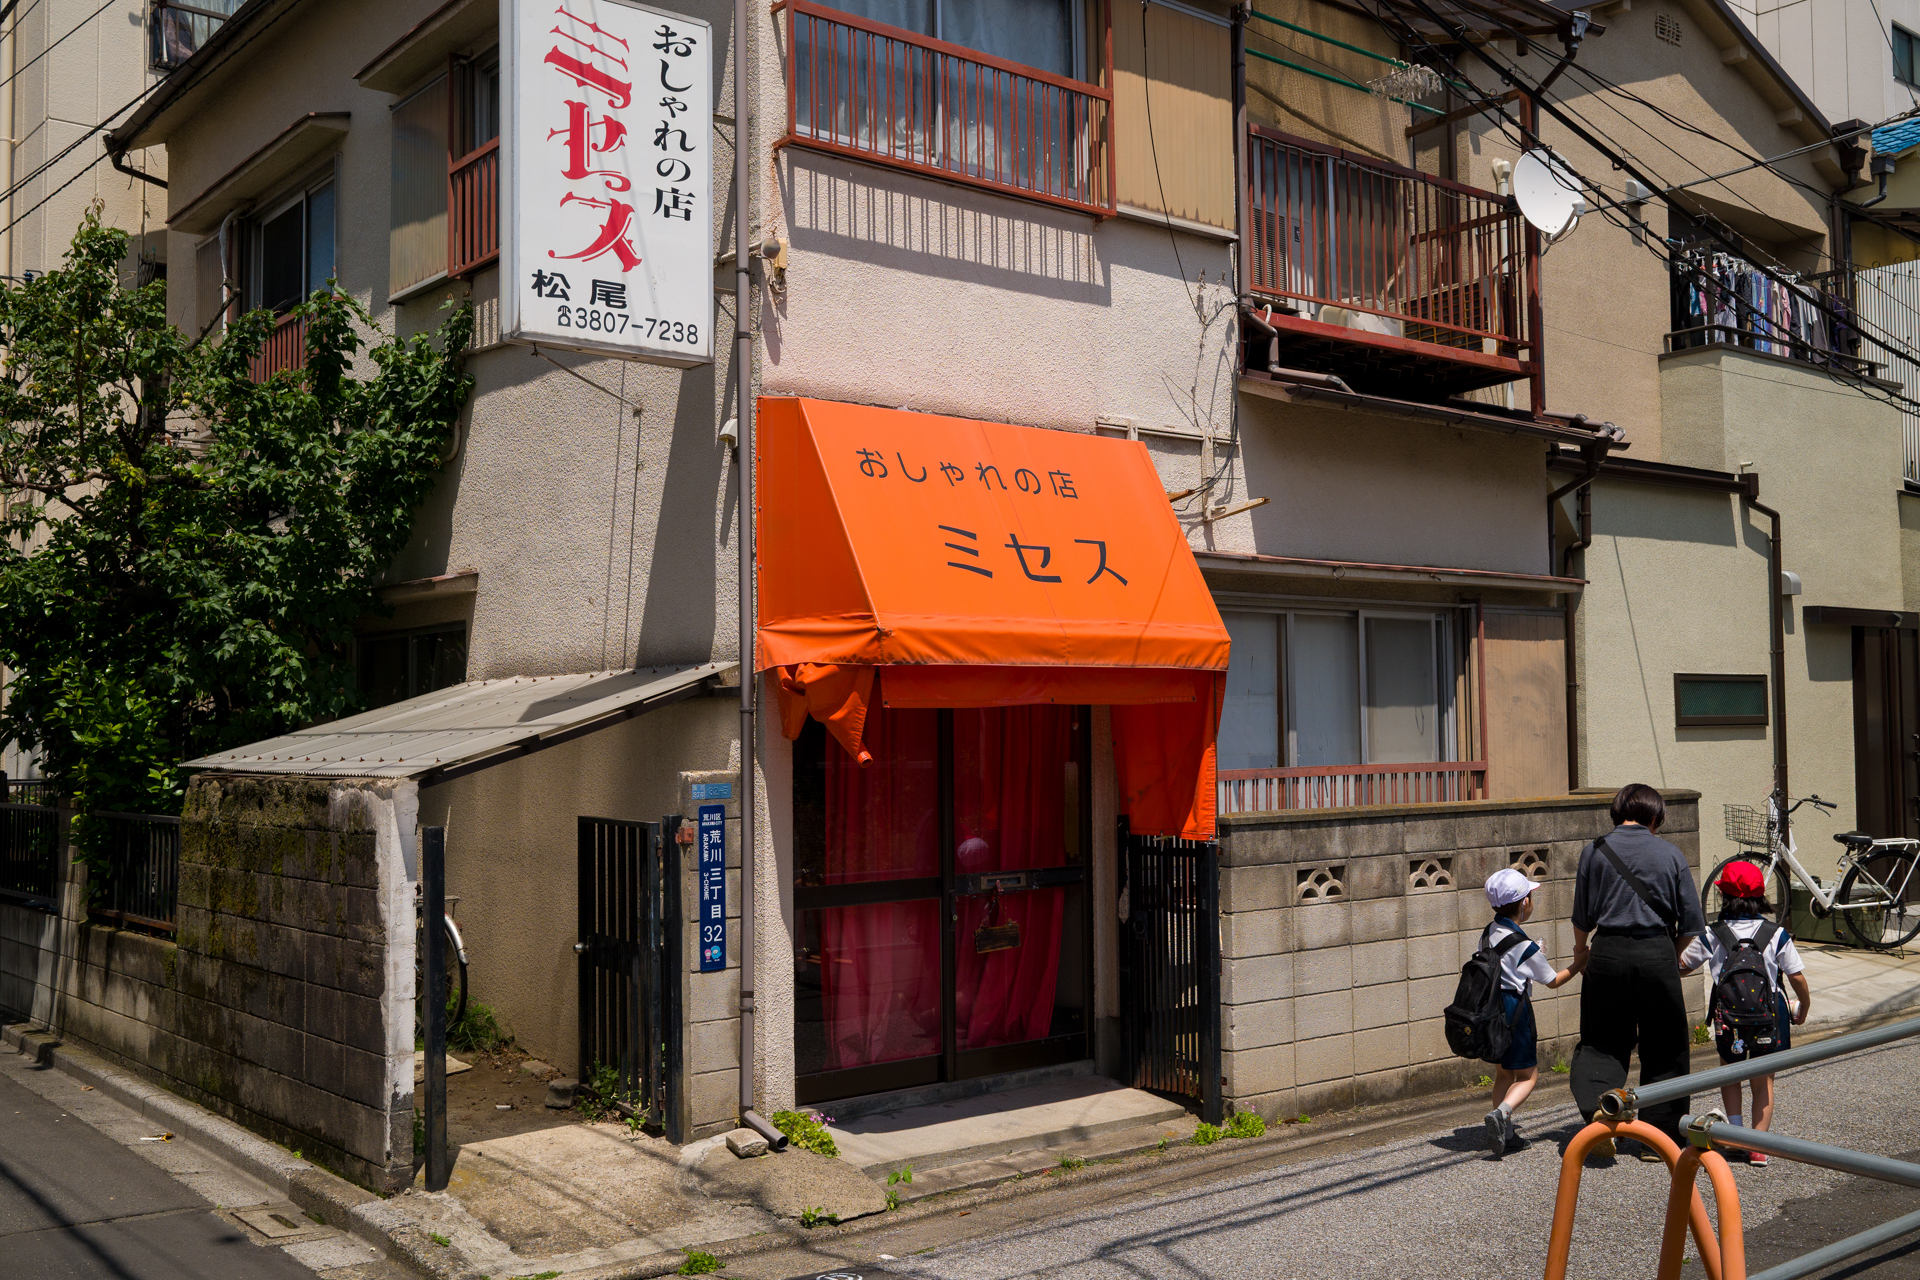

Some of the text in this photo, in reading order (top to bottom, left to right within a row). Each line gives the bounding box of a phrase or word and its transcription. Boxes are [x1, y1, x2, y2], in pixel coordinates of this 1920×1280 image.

[544, 4, 643, 273] ミセス
[652, 24, 698, 222] おしゃれの店
[531, 269, 628, 310] 松尾
[575, 307, 699, 346] 3807-7238
[855, 447, 1079, 500] おしゃれの店
[938, 524, 1129, 587] ミセス
[702, 832, 710, 863] ARAKAWA
[710, 829, 722, 919] 荒川三丁目
[703, 924, 723, 942] 32
